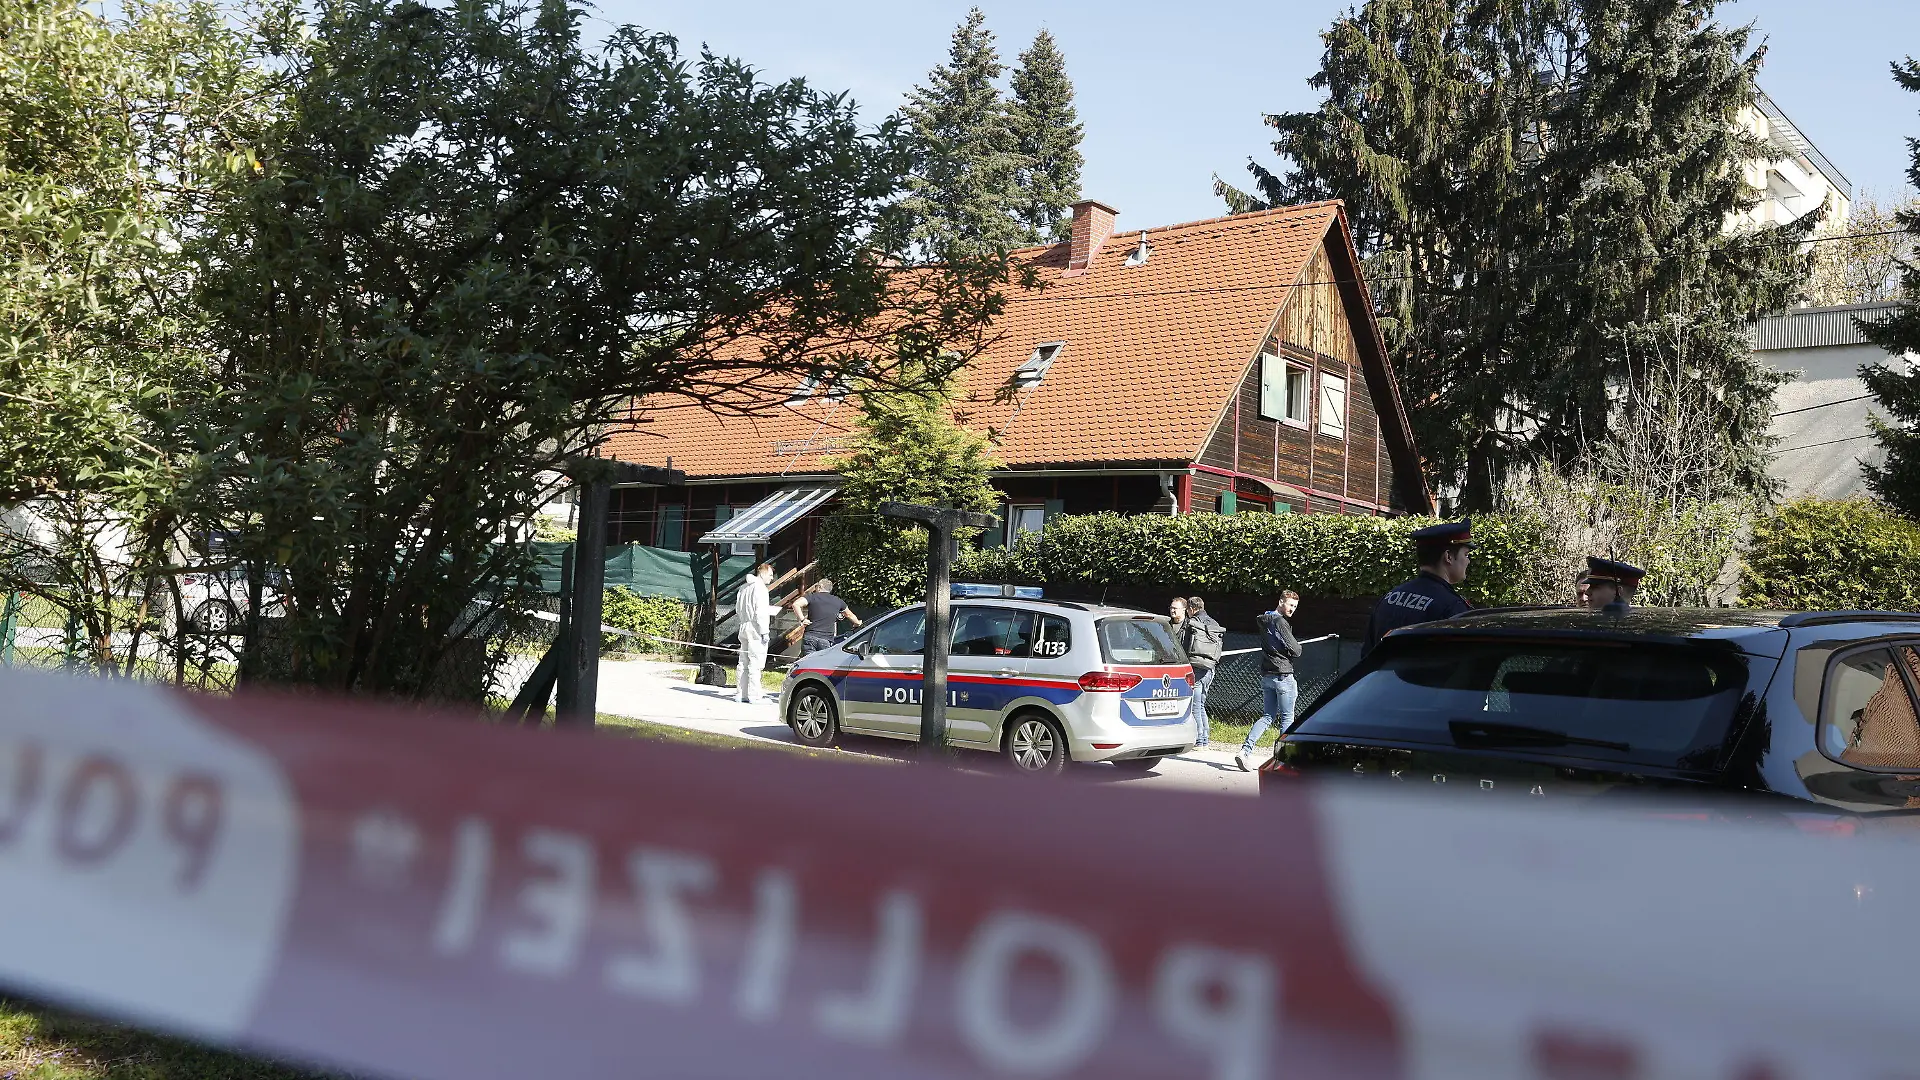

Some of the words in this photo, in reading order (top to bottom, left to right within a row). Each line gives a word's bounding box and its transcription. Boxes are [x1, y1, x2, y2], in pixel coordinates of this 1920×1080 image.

[1044, 641, 1066, 656] 133
[884, 687, 957, 707] POLII
[1152, 688, 1179, 698] POLIZEI
